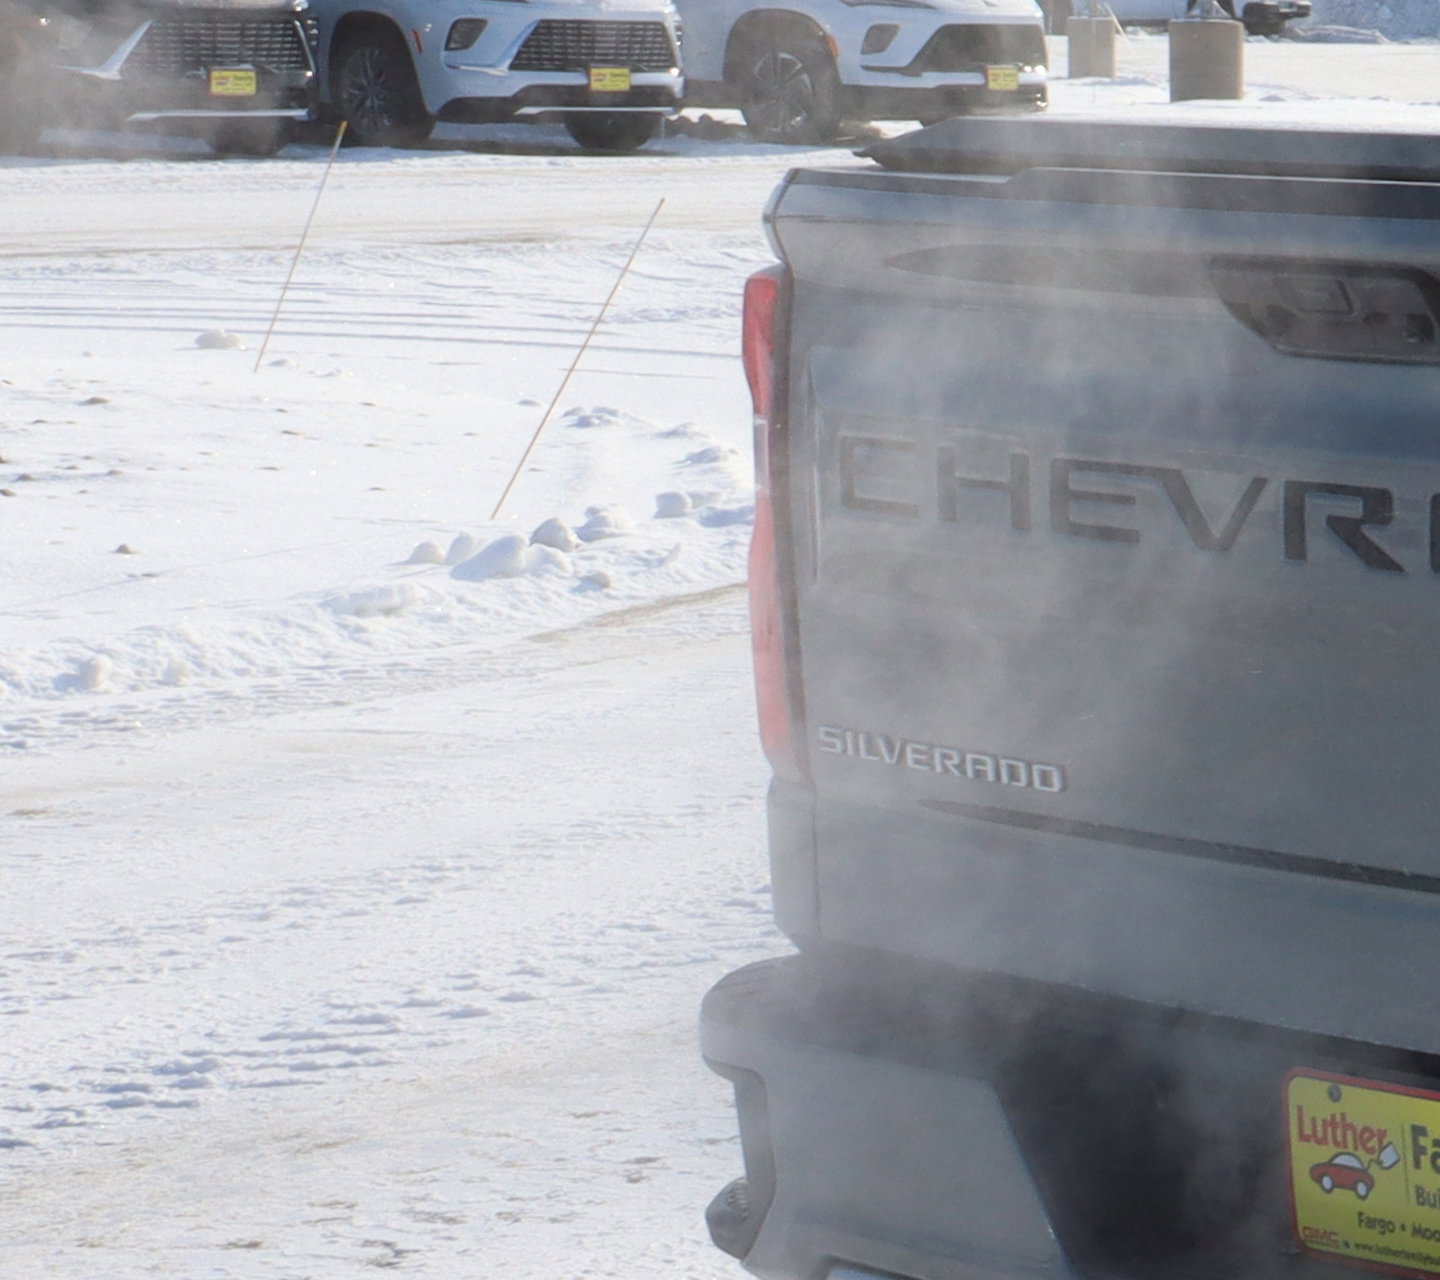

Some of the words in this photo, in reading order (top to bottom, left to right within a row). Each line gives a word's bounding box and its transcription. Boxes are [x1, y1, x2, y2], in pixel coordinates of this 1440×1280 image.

[819, 725, 1064, 793] SILVERADO
[1297, 1104, 1387, 1155] Luther
[1358, 1211, 1395, 1236] Fargo
